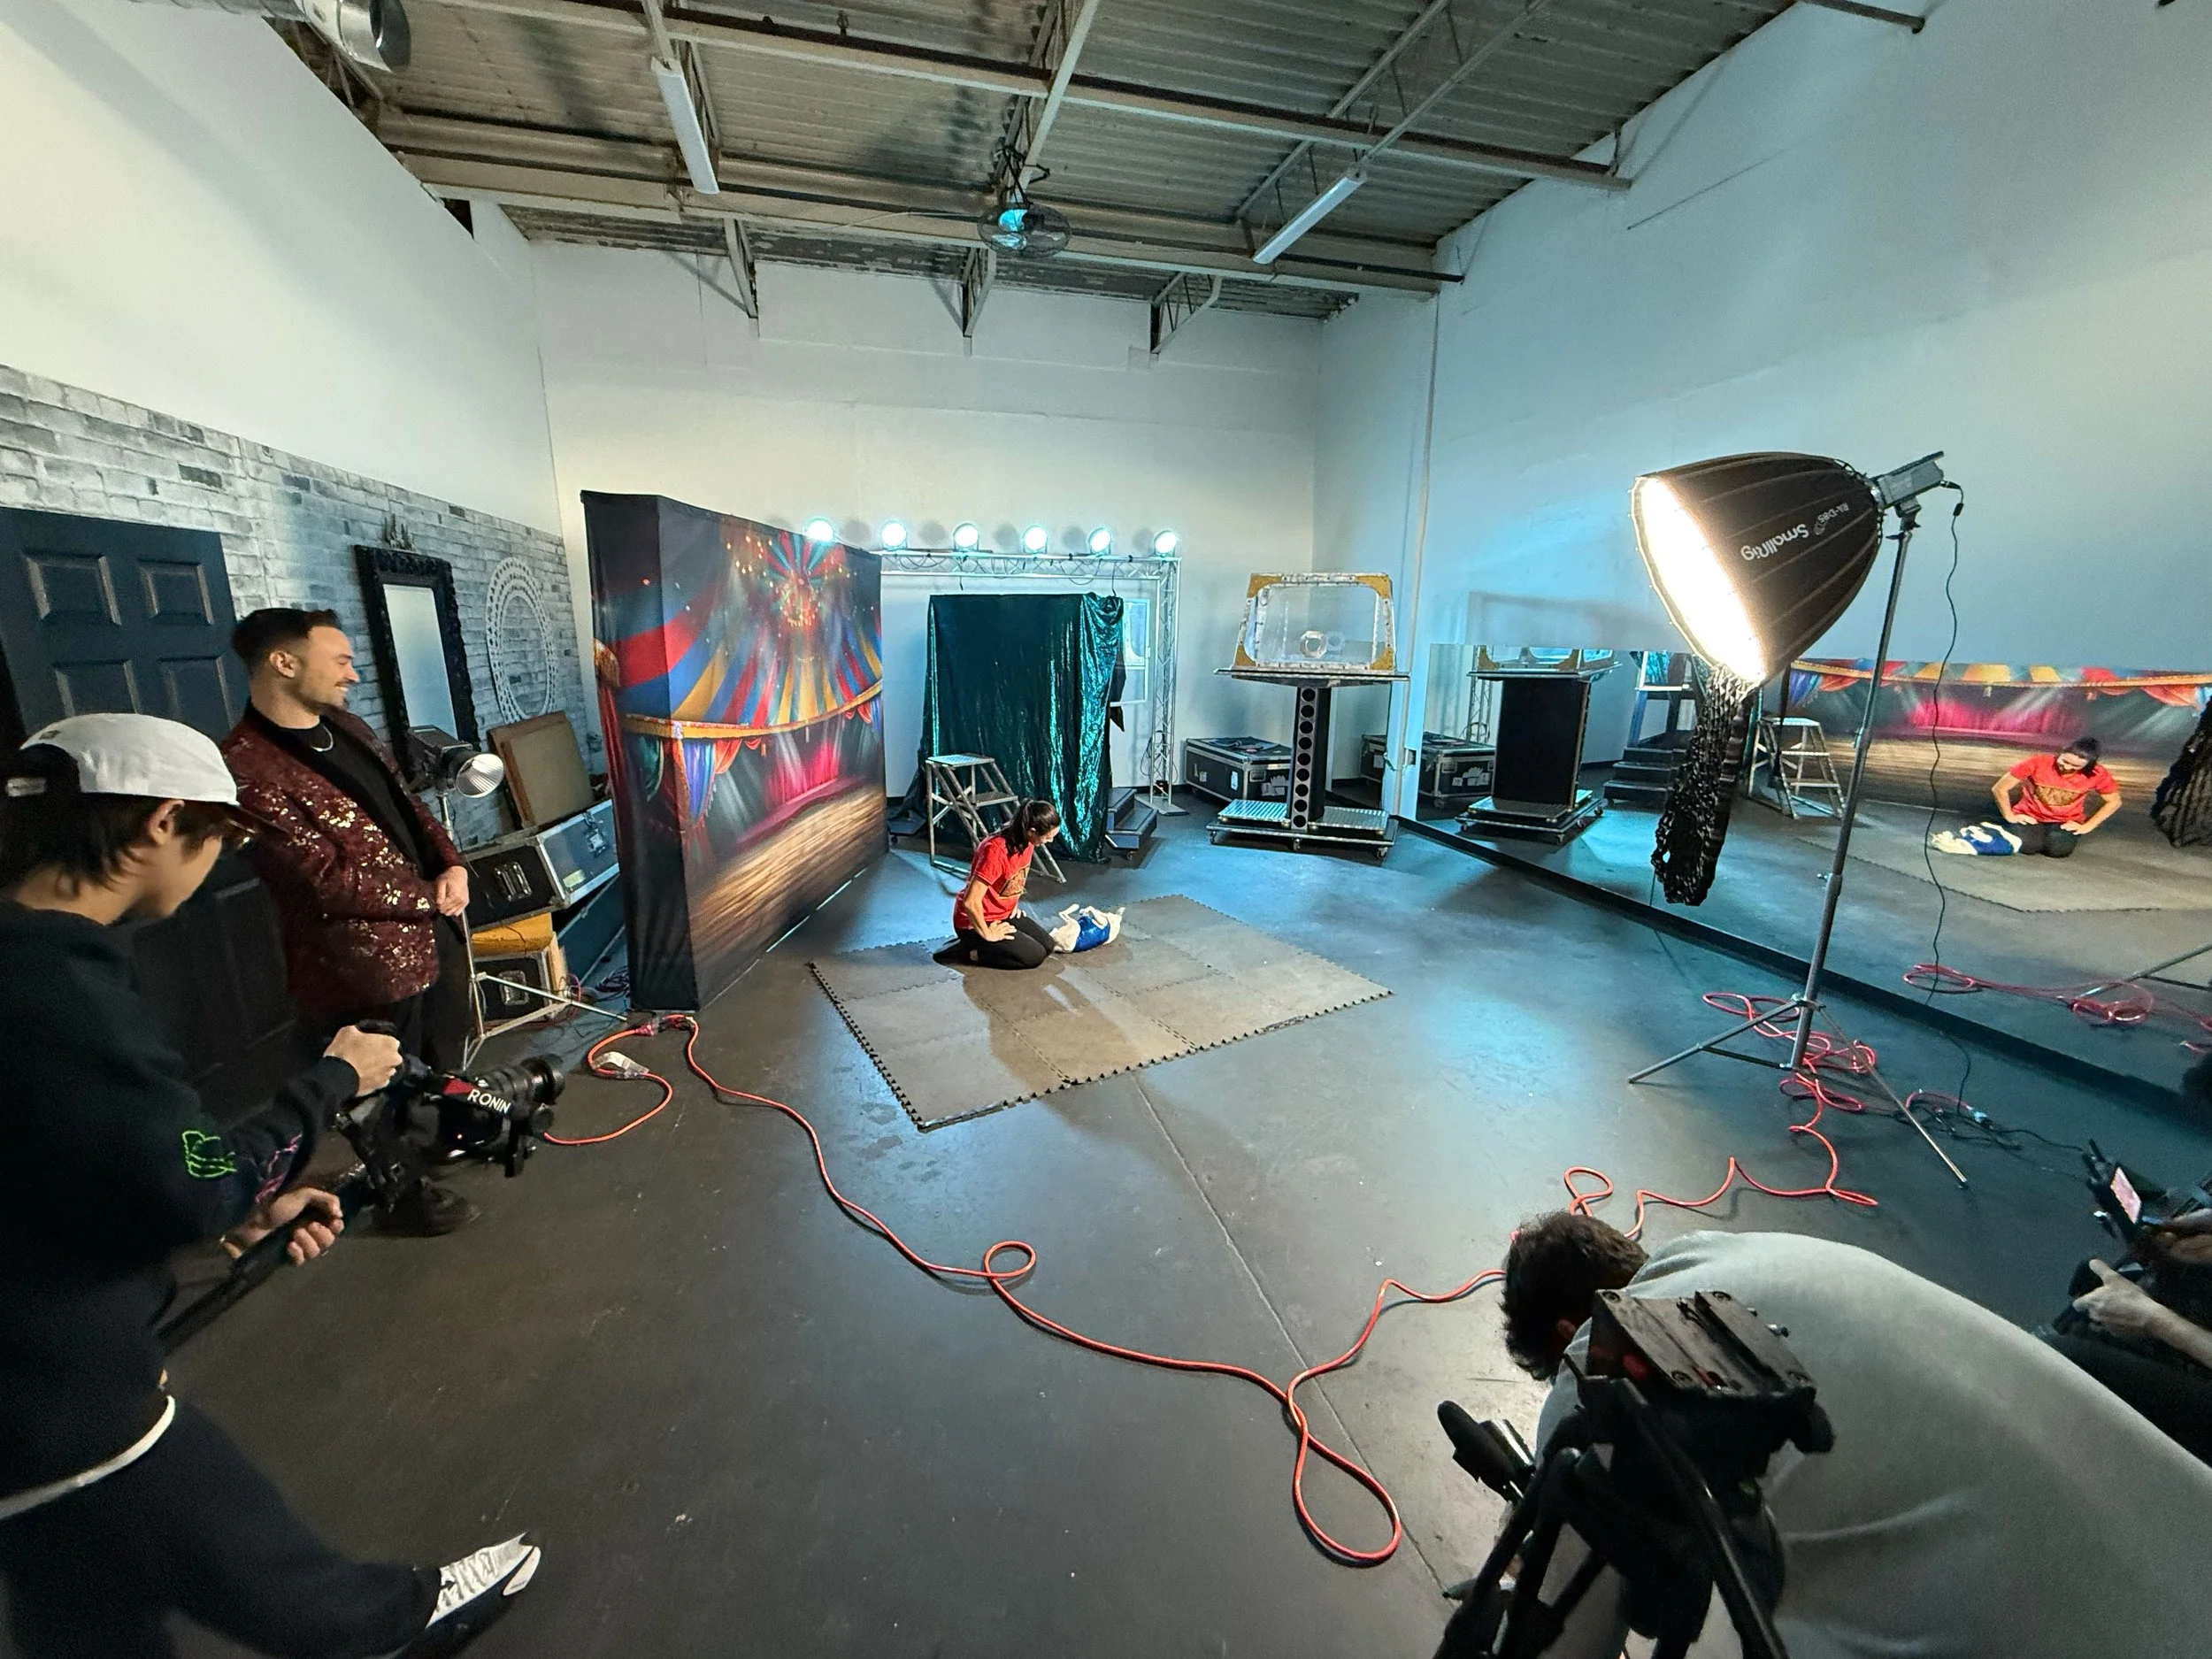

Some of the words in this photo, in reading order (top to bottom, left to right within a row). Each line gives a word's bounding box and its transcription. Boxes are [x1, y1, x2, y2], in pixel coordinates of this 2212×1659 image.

[1817, 503, 1849, 523] RA-D85
[1740, 524, 1809, 561] SmallRig
[467, 1088, 511, 1114] RONIN
